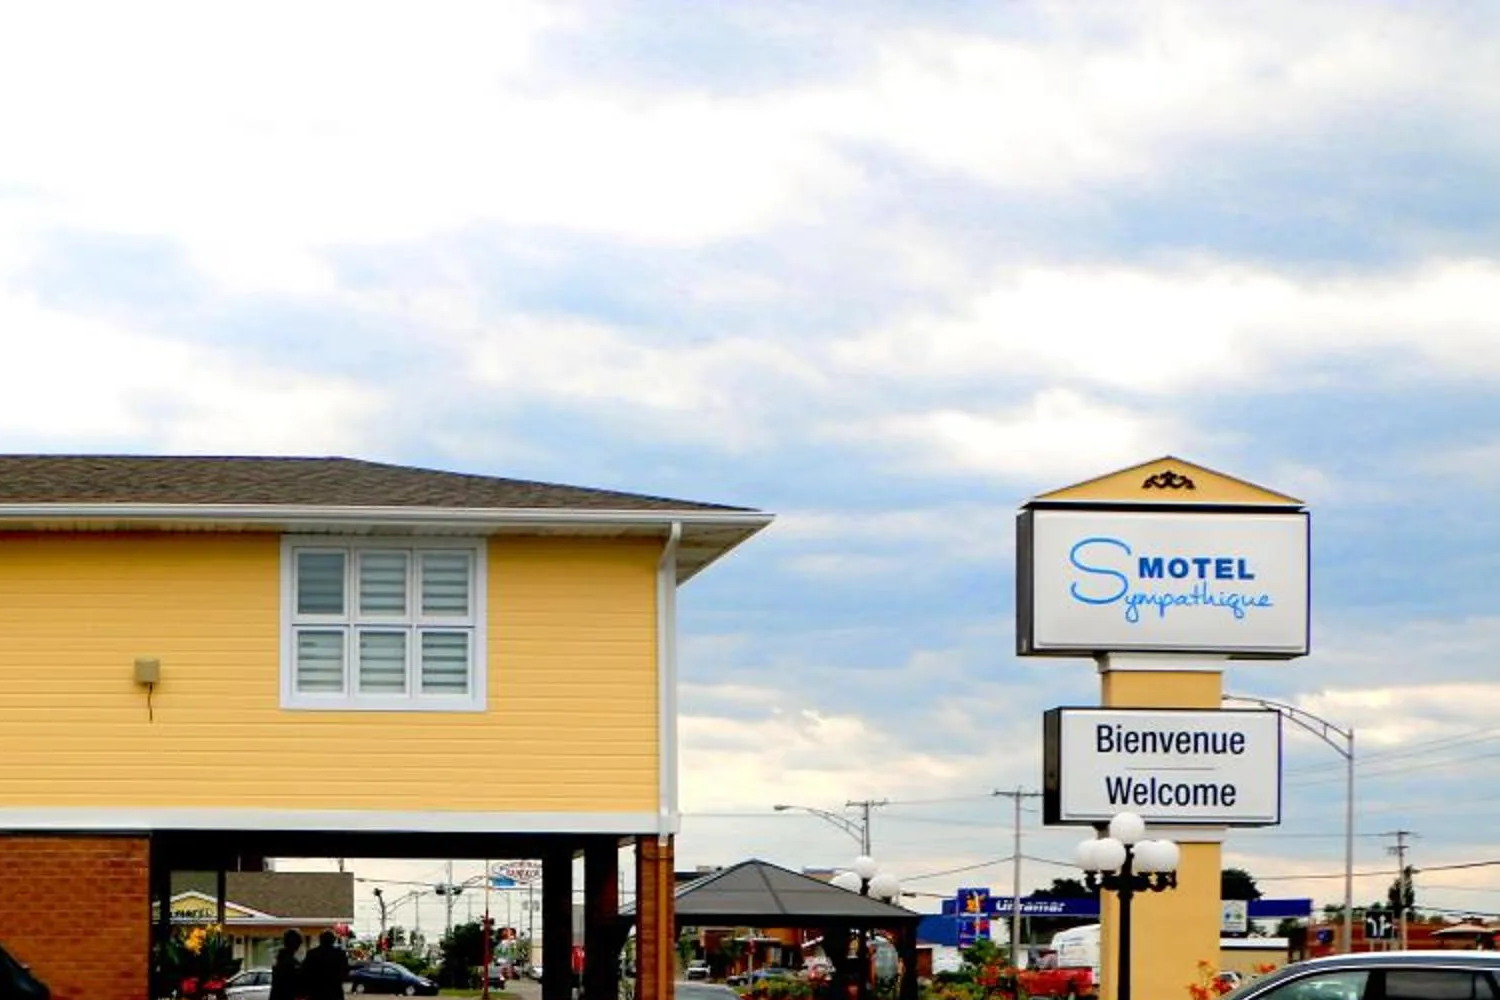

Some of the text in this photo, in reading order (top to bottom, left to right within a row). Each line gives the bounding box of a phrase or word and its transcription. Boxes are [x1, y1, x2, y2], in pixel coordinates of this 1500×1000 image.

[1070, 537, 1274, 623] Sympathique
[1138, 557, 1255, 580] MOTEL
[1096, 724, 1246, 754] Bienvenue
[1105, 776, 1237, 807] Welcome
[995, 899, 1066, 912] Ulramar
